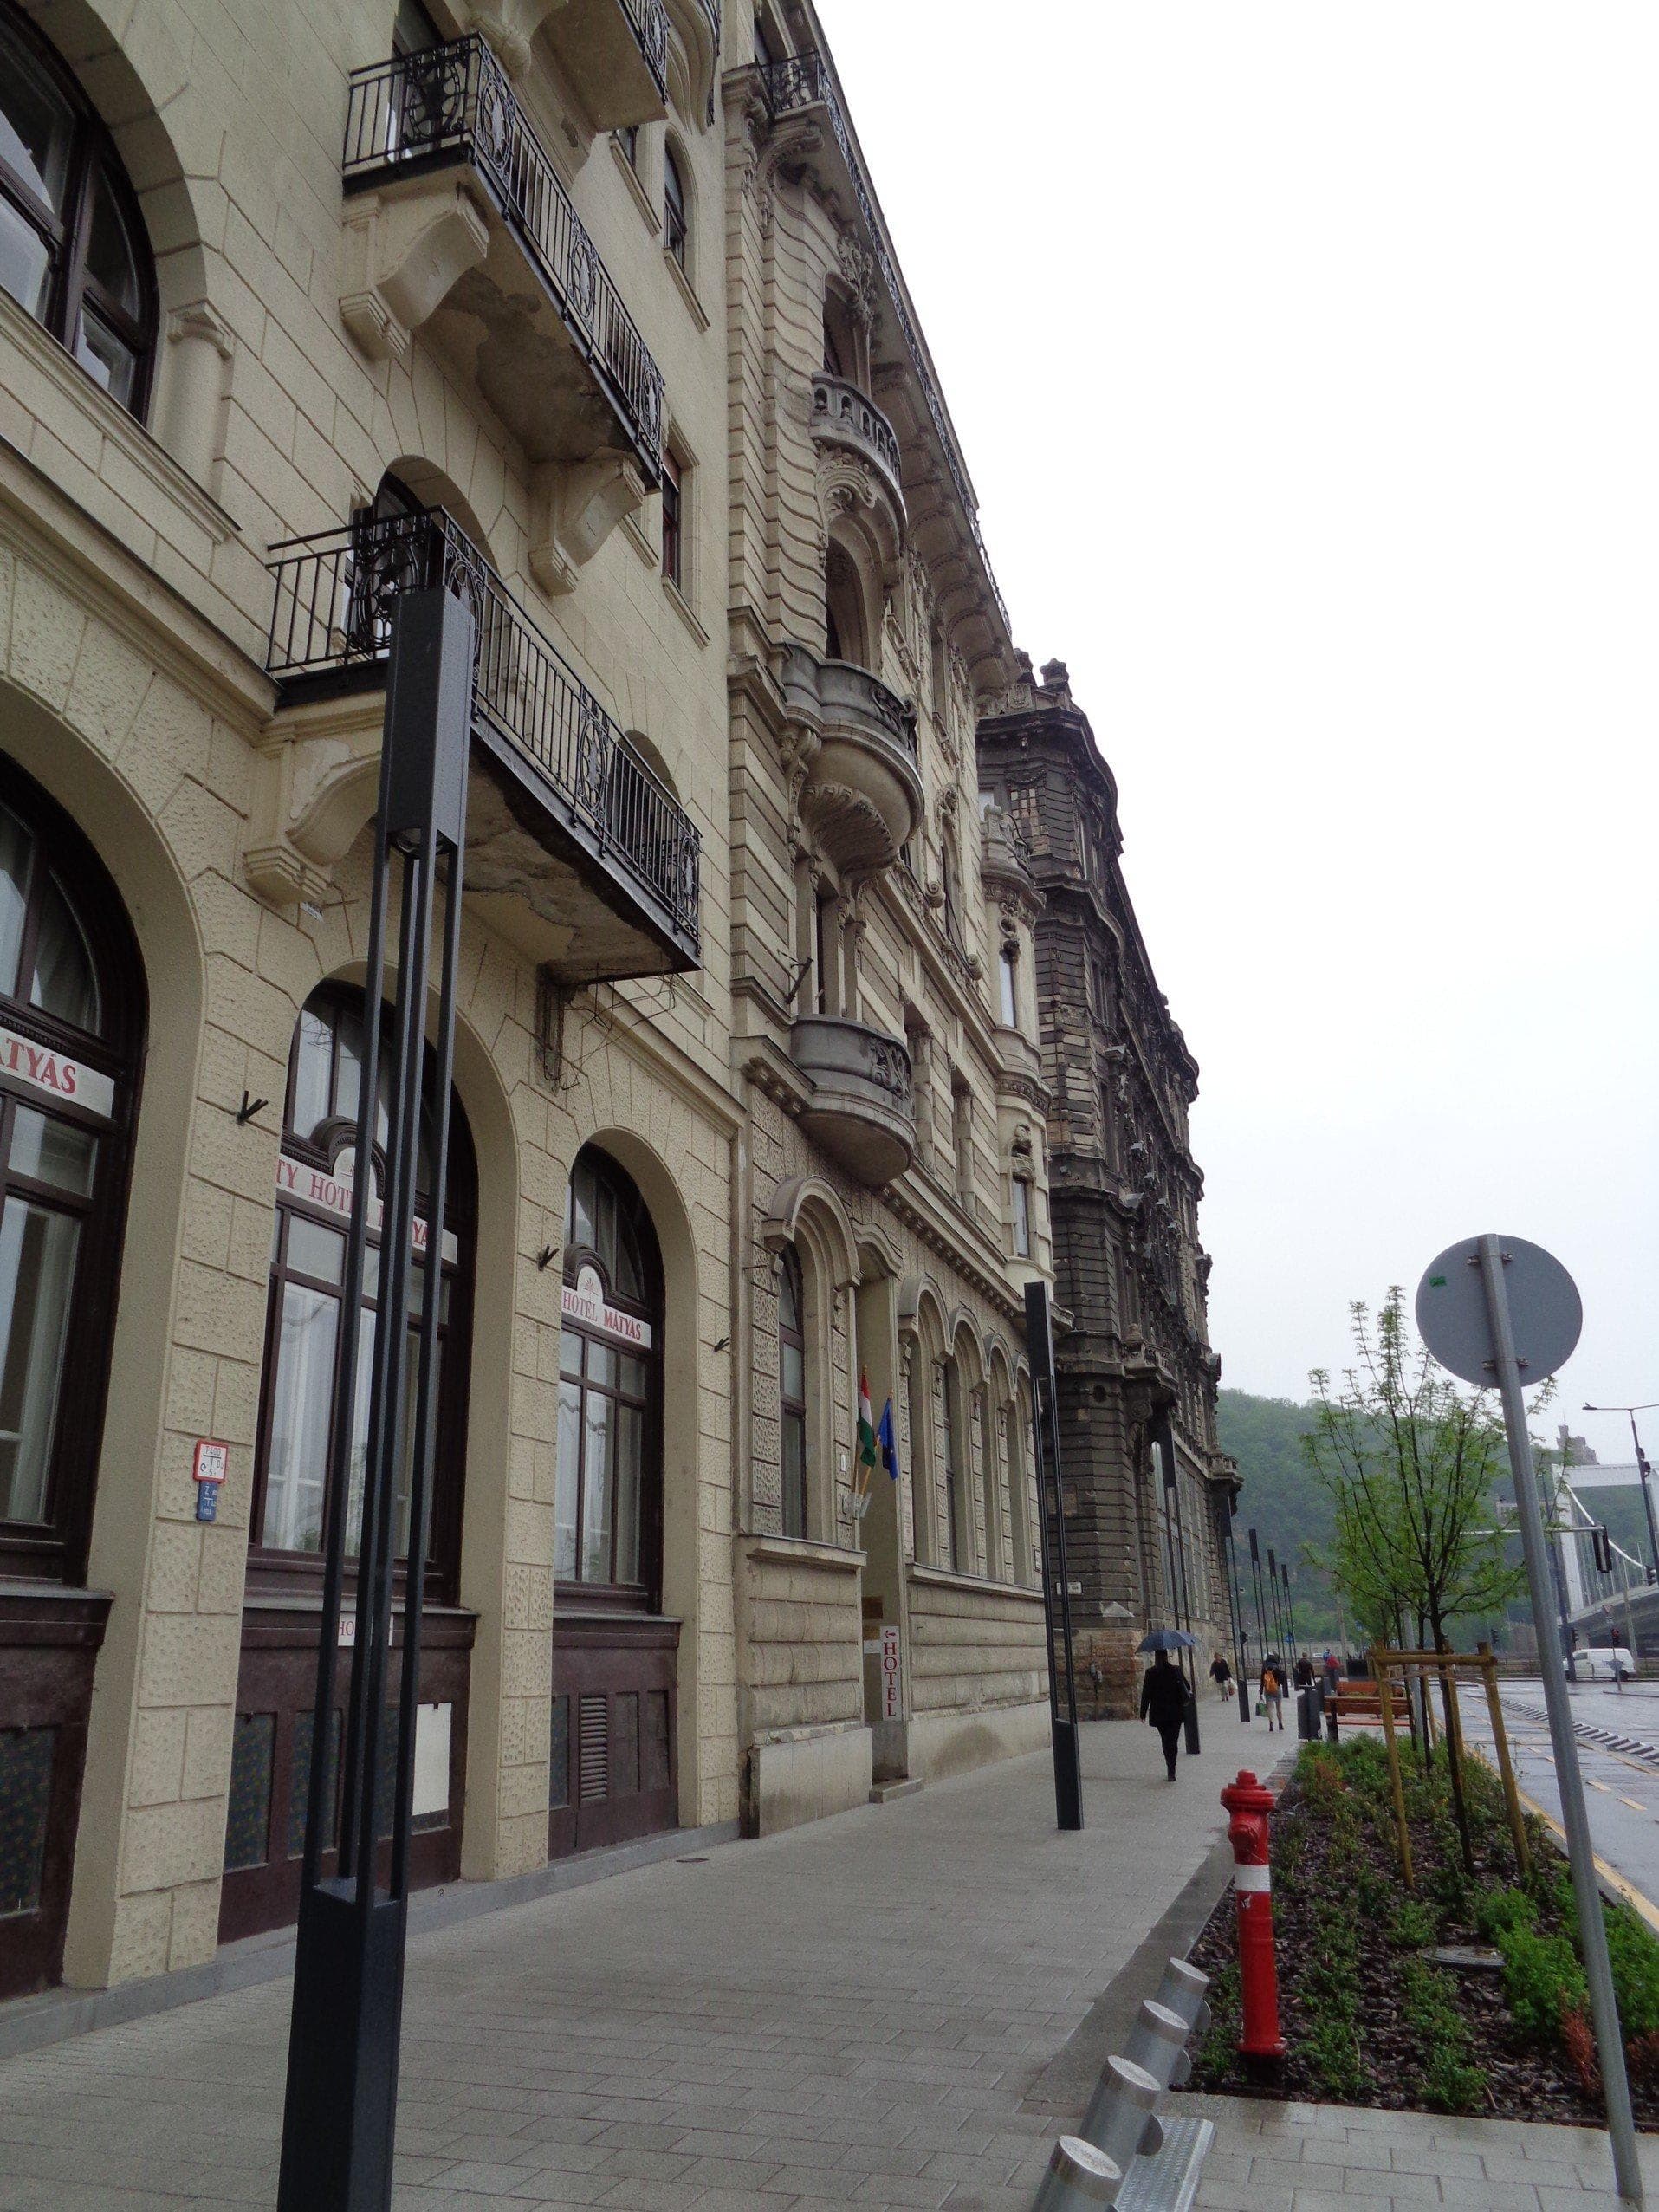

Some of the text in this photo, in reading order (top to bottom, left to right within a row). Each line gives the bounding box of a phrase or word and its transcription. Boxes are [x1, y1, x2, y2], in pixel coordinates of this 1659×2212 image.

[0, 1038, 76, 1094] TYÁS
[276, 1158, 298, 1190] TY
[563, 1290, 641, 1340] HOTEL MÁTYÁS
[884, 1642, 898, 1716] HOTEL
